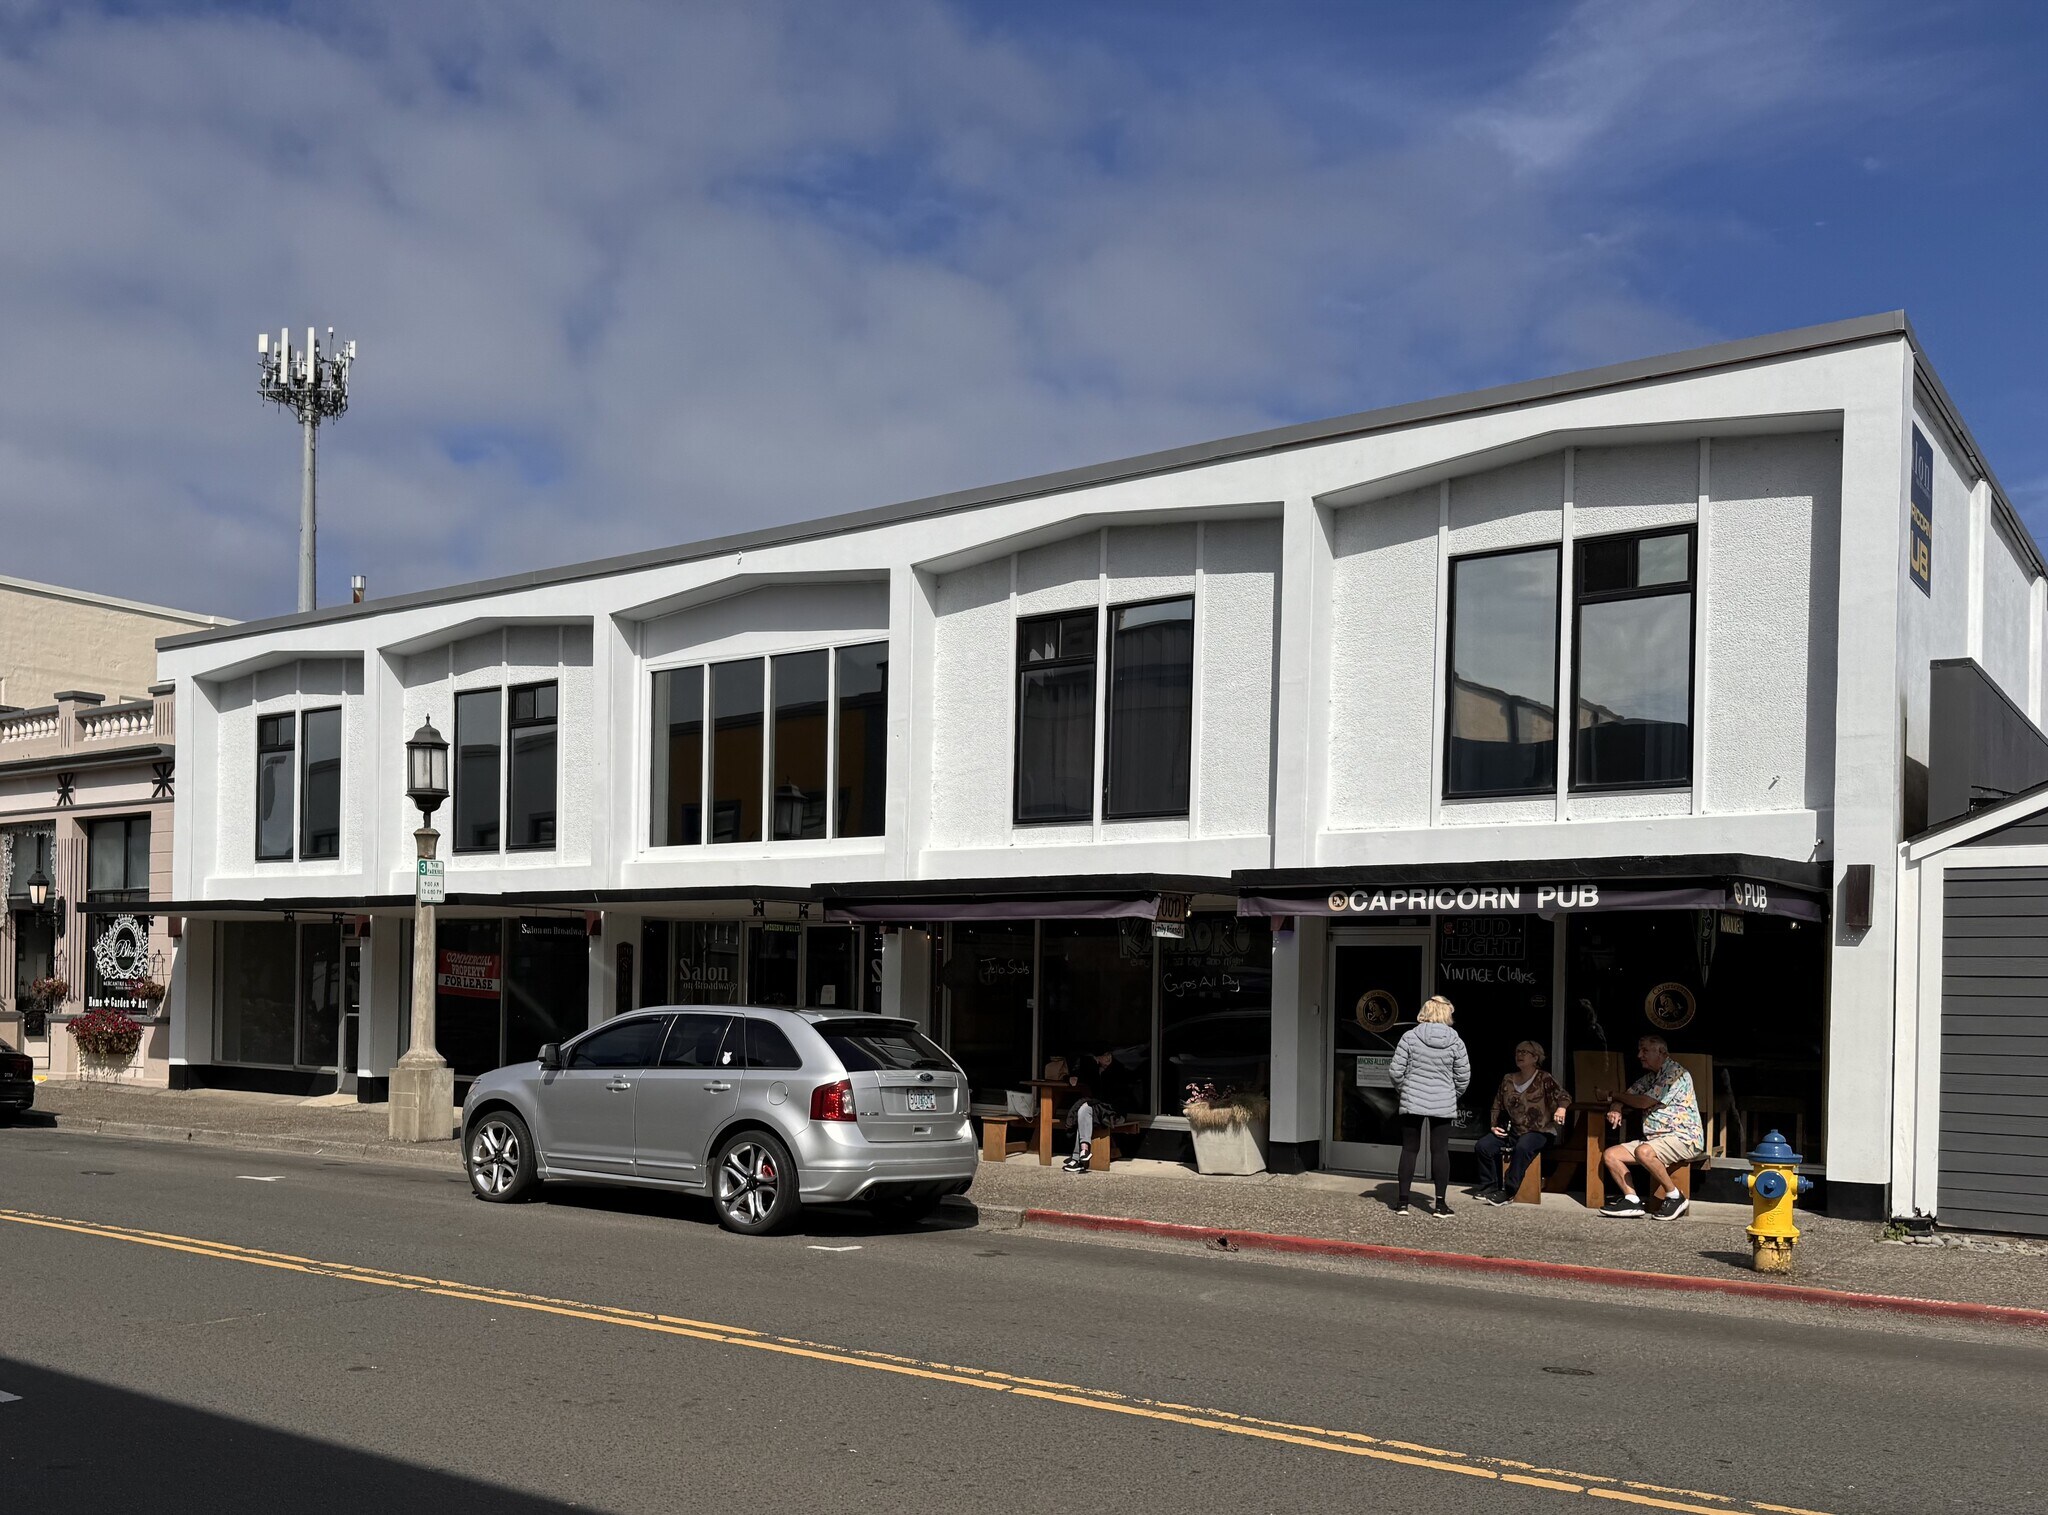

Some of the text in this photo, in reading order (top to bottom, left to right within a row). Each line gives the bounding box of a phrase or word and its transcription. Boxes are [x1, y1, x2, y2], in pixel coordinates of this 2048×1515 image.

[1913, 441, 1930, 492] lon
[1910, 530, 1928, 582] UB
[420, 863, 426, 873] 3
[1349, 884, 1600, 911] CAPRICORN PUB
[1744, 882, 1767, 908] PUB
[521, 923, 542, 934] Salon
[543, 927, 552, 935] on
[1456, 917, 1511, 937] BUD
[115, 939, 137, 957] Bliss
[1445, 937, 1521, 956] LIGHT
[446, 952, 492, 966] COMMERCIAL
[980, 957, 1005, 975] Jello
[451, 964, 486, 977] PROPERTY
[680, 957, 728, 981] Salon
[444, 976, 493, 990] FOR LEASE
[1163, 973, 1241, 997] Gyros All Day
[88, 996, 103, 1008] Home
[110, 996, 130, 1008] Garden
[1457, 1109, 1473, 1123] age
